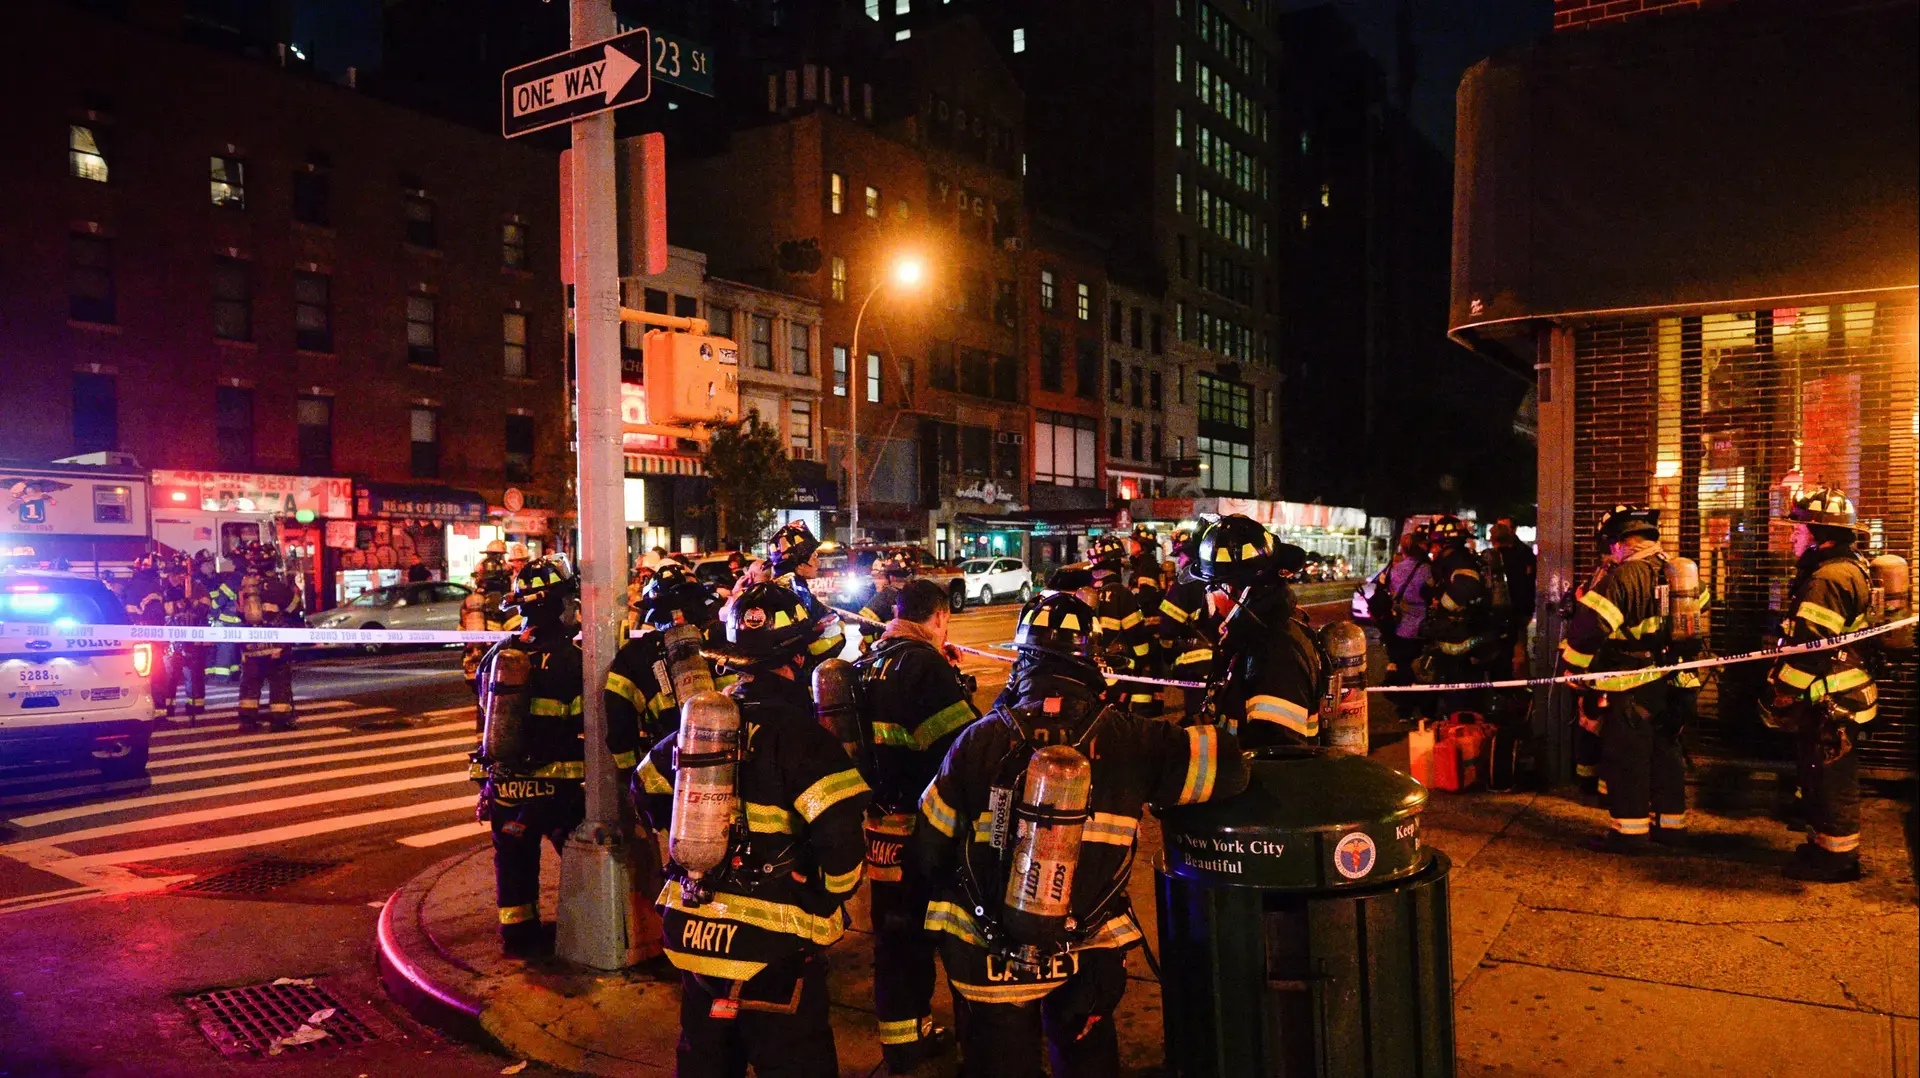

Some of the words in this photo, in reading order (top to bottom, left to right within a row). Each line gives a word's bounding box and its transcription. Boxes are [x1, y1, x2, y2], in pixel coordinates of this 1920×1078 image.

[655, 36, 681, 78] 23
[691, 50, 707, 75] St
[518, 78, 555, 112] ONE
[565, 62, 608, 98] WAY
[257, 476, 296, 491] BEST
[66, 640, 122, 649] POLICE
[20, 669, 49, 681] 5288
[1395, 822, 1415, 840] Keep
[866, 840, 904, 865] HAKE
[1185, 833, 1208, 849] New
[1212, 838, 1245, 854] York
[1249, 840, 1285, 858] City
[1184, 852, 1243, 874] Beautiful
[1051, 863, 1067, 902] SCOTT
[682, 919, 739, 954] PARTY
